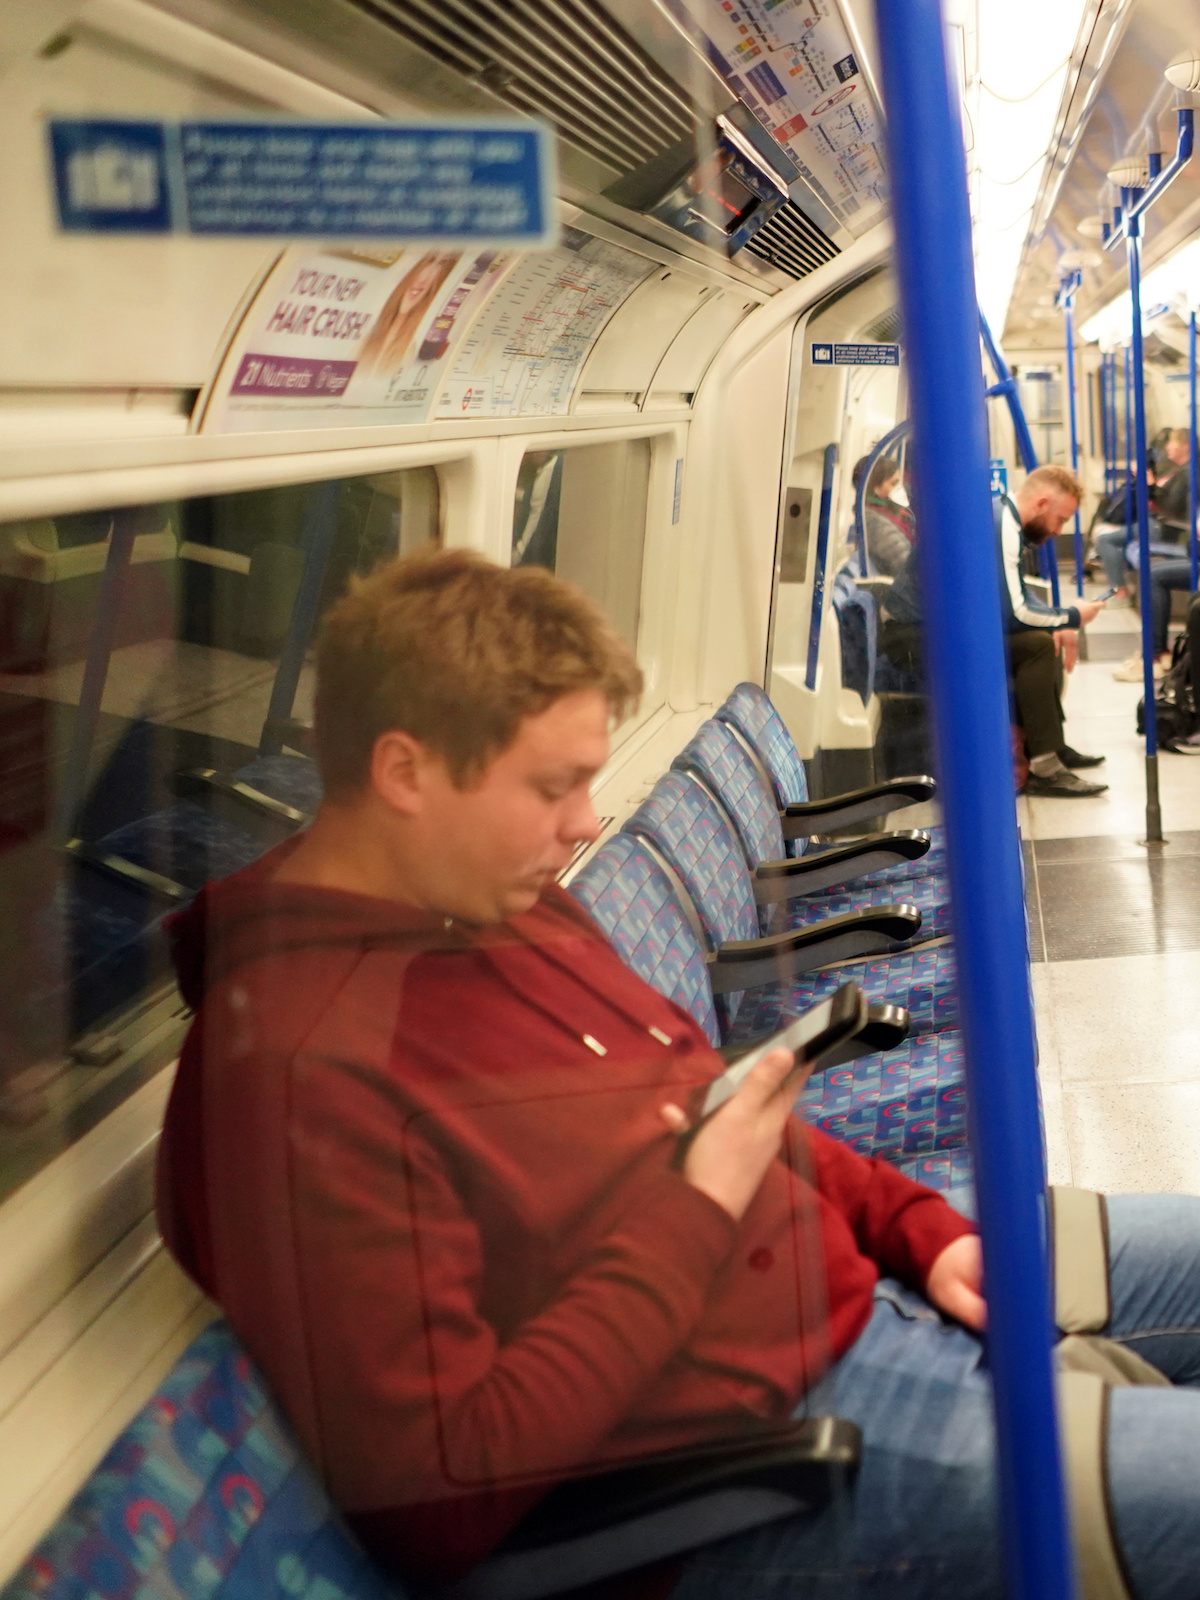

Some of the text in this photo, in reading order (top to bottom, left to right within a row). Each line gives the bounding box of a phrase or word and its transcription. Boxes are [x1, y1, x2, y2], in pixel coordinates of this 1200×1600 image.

[290, 269, 368, 302] YOUR NEW
[265, 301, 316, 335] HAIR
[240, 361, 262, 386] 21
[257, 361, 313, 389] Nutrients
